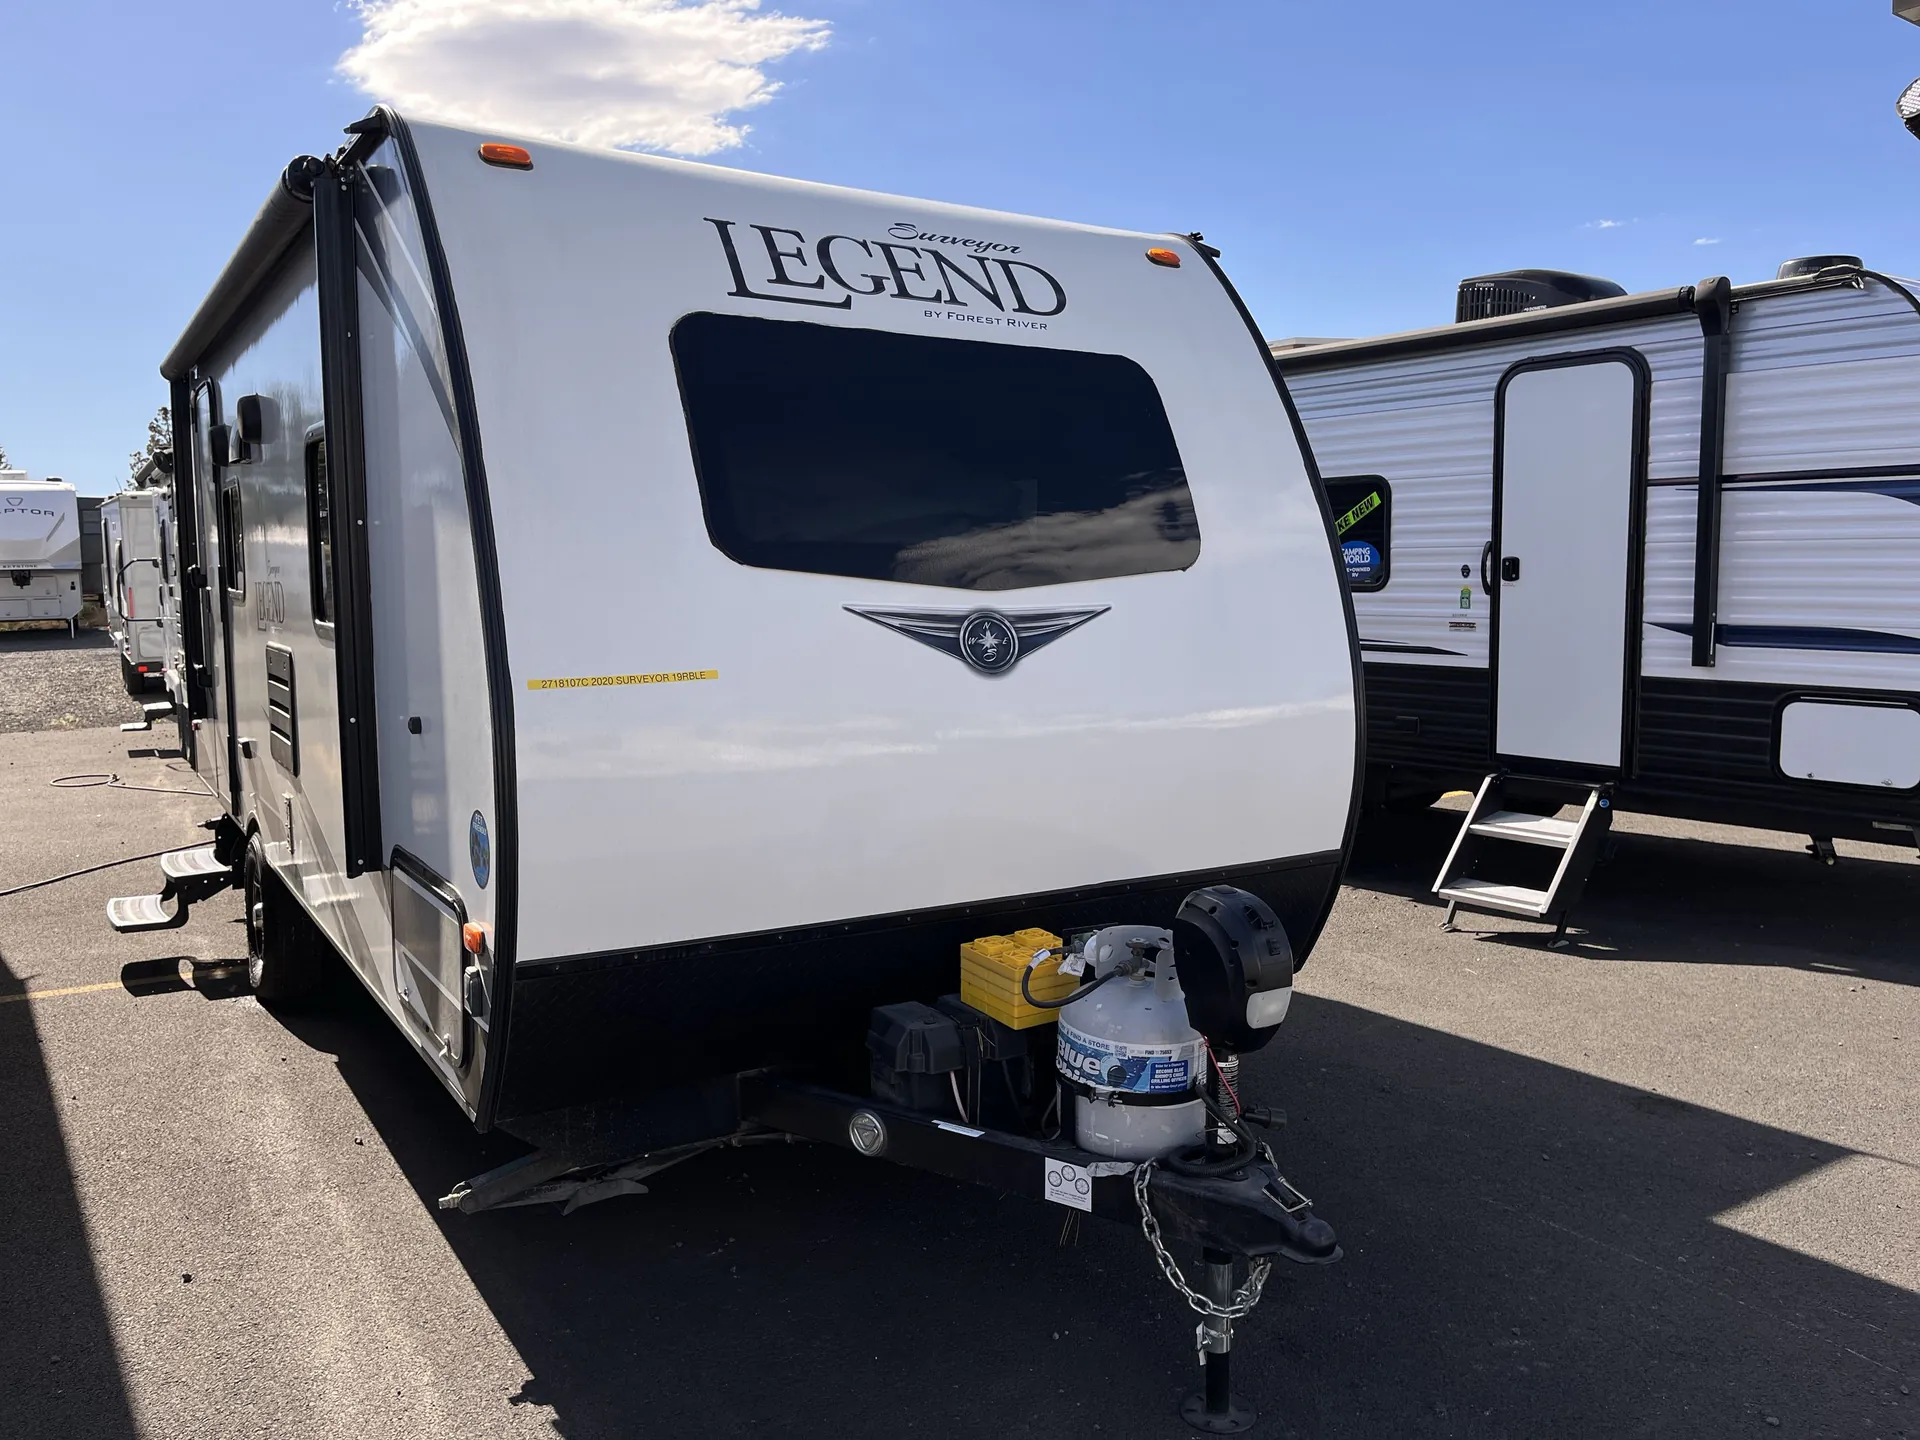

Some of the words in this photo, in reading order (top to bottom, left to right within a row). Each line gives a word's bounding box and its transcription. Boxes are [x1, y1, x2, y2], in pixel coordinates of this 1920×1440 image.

[888, 222, 1023, 255] Surveyor
[702, 216, 1067, 317] LEGEND
[924, 310, 942, 319] BY
[947, 312, 1002, 325] FOREST
[1007, 318, 1048, 331] RIVER
[0, 507, 55, 517] PTOR
[1352, 495, 1375, 521] NEW
[254, 581, 285, 632] LEGEND
[982, 621, 991, 630] N
[968, 637, 978, 645] W
[1002, 637, 1009, 645] E
[541, 677, 589, 689] 2718107C
[591, 676, 614, 686] 2020
[616, 673, 670, 685] SURVEYOR
[672, 670, 707, 682] 19RBLE
[1058, 1037, 1101, 1075] Blue
[1088, 1040, 1110, 1051] STORE
